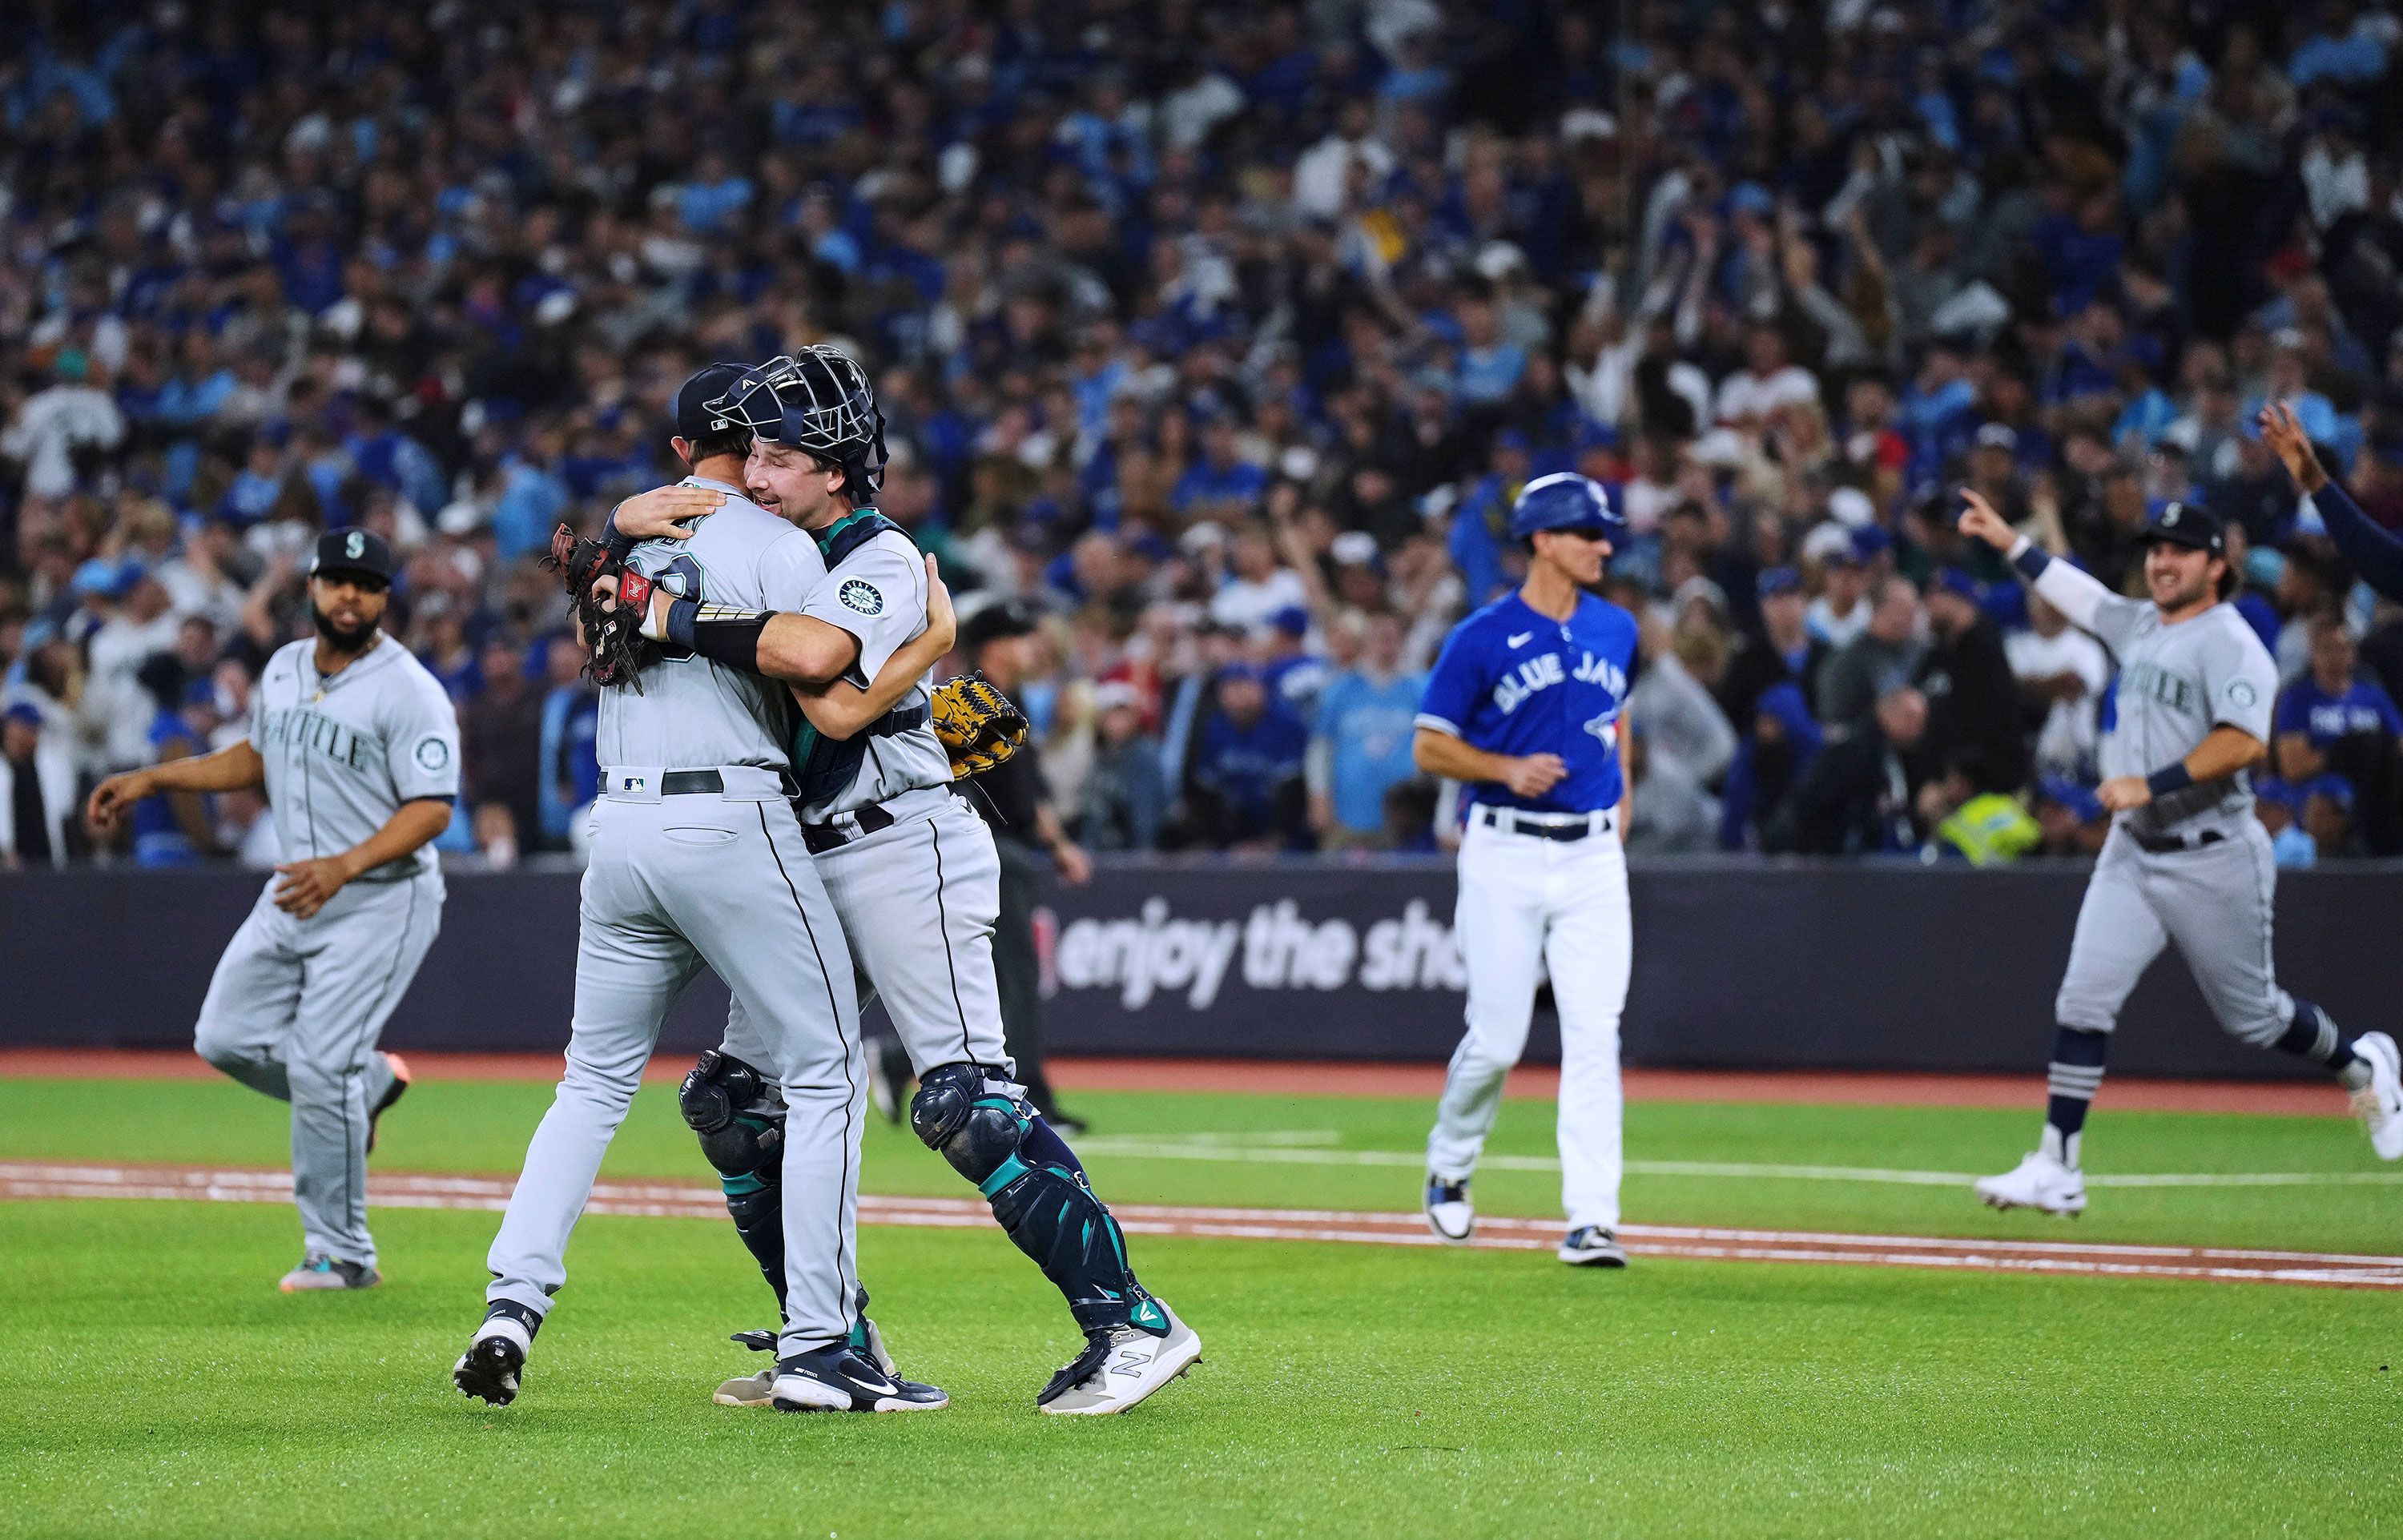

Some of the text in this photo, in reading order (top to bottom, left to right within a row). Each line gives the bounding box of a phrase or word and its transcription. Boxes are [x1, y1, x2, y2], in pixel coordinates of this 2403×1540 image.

[840, 594, 879, 614] MARINERS
[846, 581, 882, 605] SEATTLE
[1493, 653, 1566, 715] BLUE
[1058, 896, 1239, 1011] enjoy
[1243, 896, 1358, 991] the
